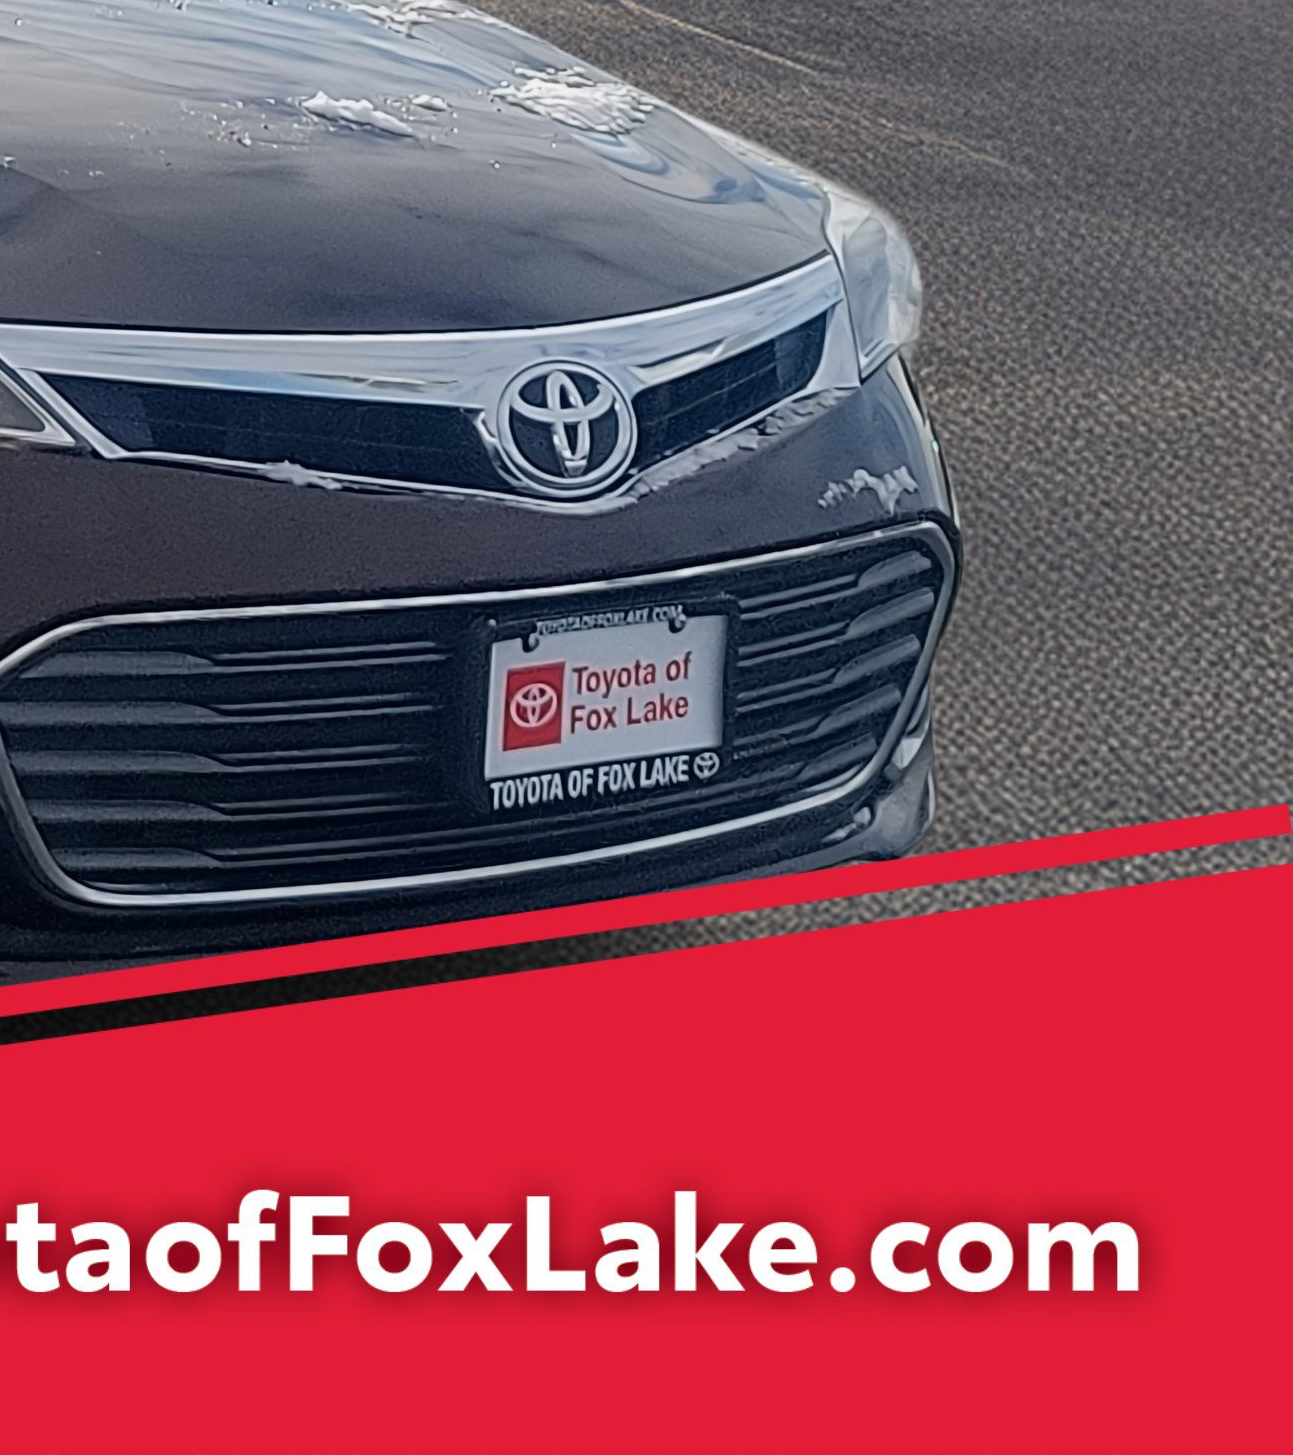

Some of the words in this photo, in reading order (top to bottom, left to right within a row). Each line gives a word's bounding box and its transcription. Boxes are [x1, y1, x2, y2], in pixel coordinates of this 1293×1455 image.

[572, 660, 656, 699] Toyota
[666, 651, 692, 681] of
[570, 704, 617, 734] Fox
[627, 693, 689, 725] Lake
[490, 772, 564, 810] TOYOTA
[567, 768, 594, 798] OF
[597, 761, 637, 793] FOX
[640, 755, 690, 788] LAKE
